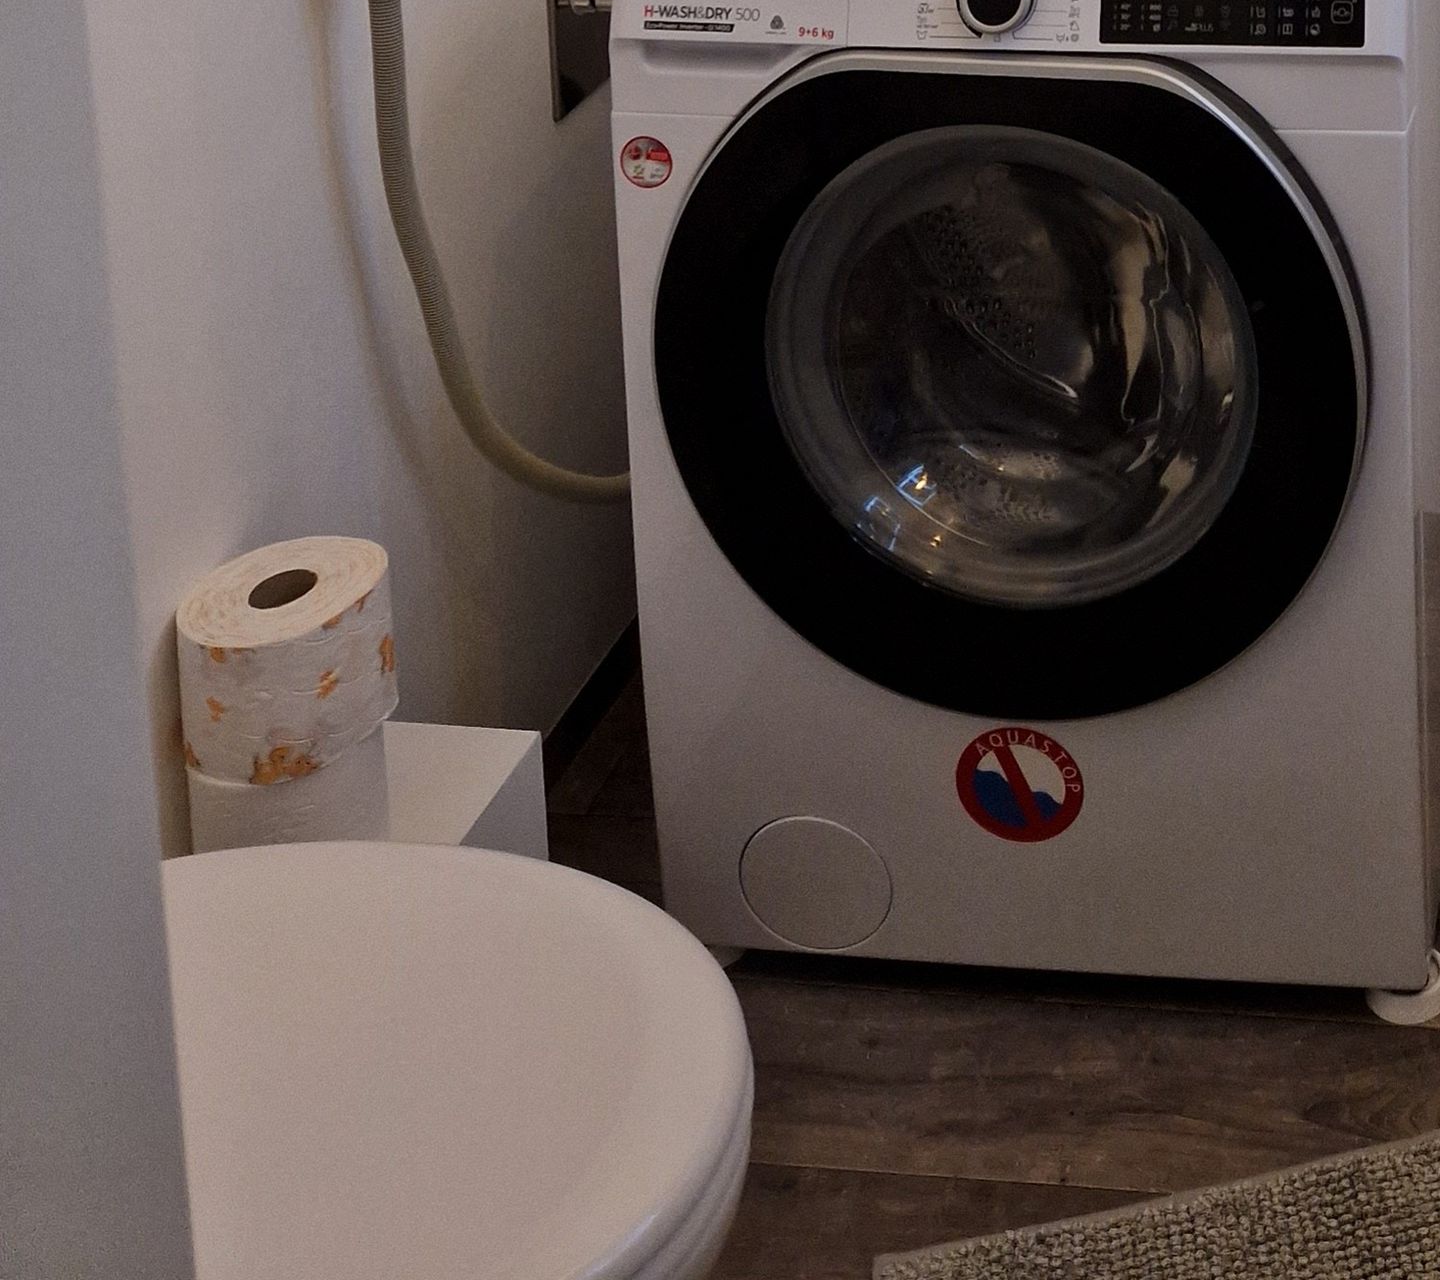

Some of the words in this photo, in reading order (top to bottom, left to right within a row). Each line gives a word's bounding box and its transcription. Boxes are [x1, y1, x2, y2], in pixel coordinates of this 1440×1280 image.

[644, 4, 732, 20] H-WASH&DRY
[736, 8, 761, 22] 500
[798, 26, 819, 38] 9+6
[822, 28, 835, 40] kg
[974, 729, 1081, 793] AQUASTOP
